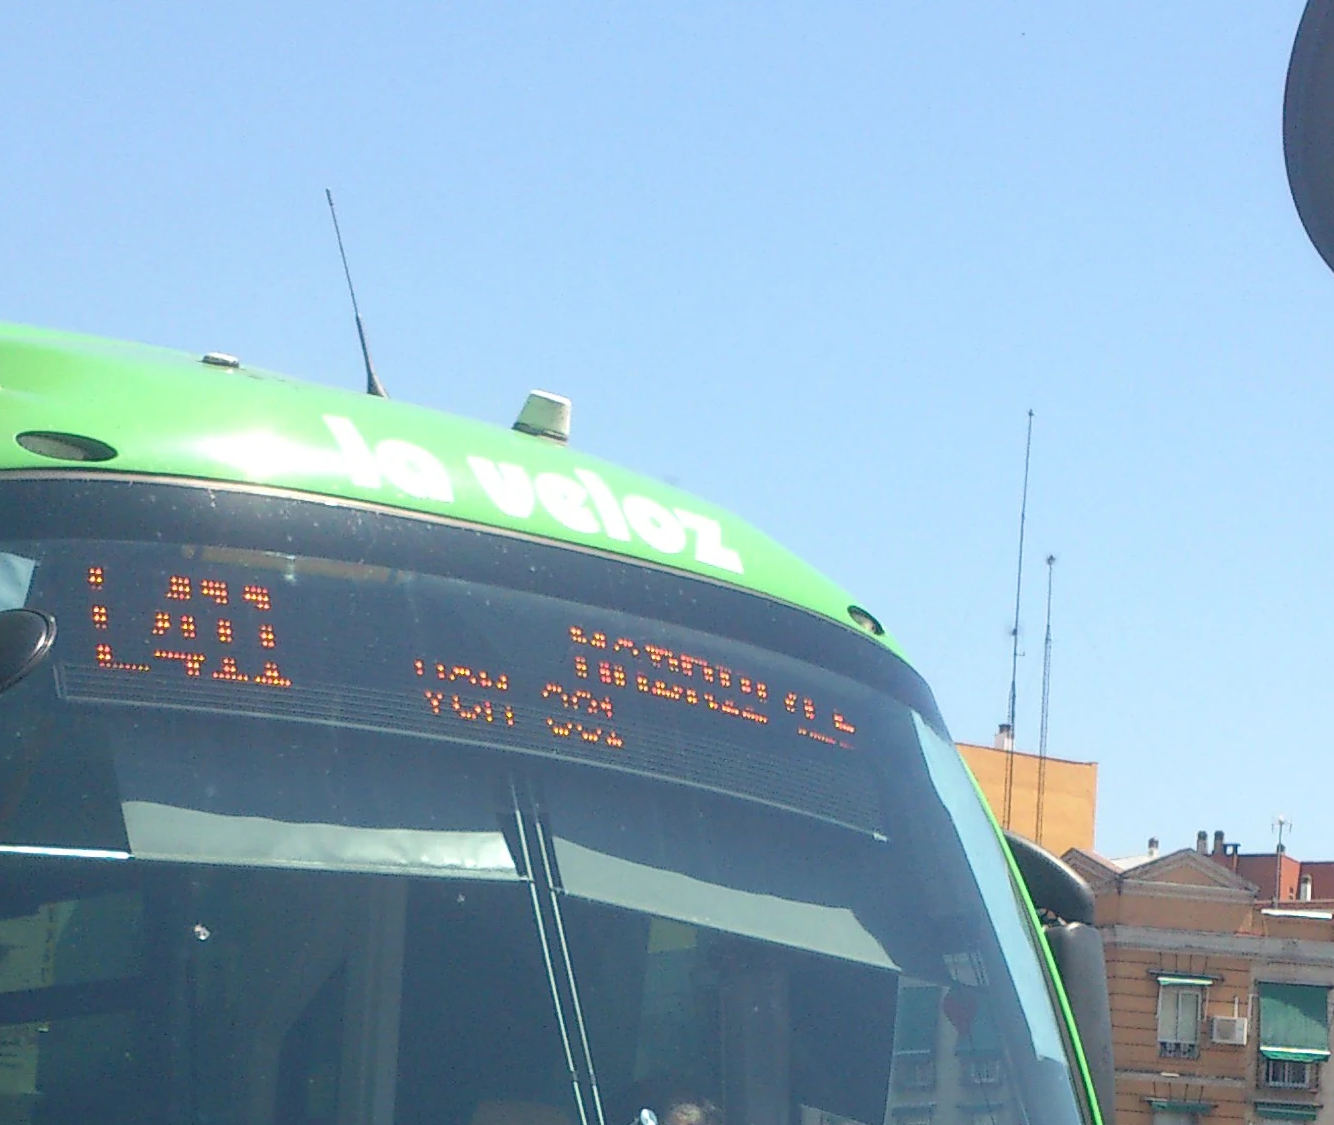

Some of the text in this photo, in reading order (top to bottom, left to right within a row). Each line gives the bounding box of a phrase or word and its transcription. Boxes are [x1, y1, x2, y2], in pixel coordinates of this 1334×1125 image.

[322, 413, 745, 575] la veloz
[87, 566, 292, 687] L411
